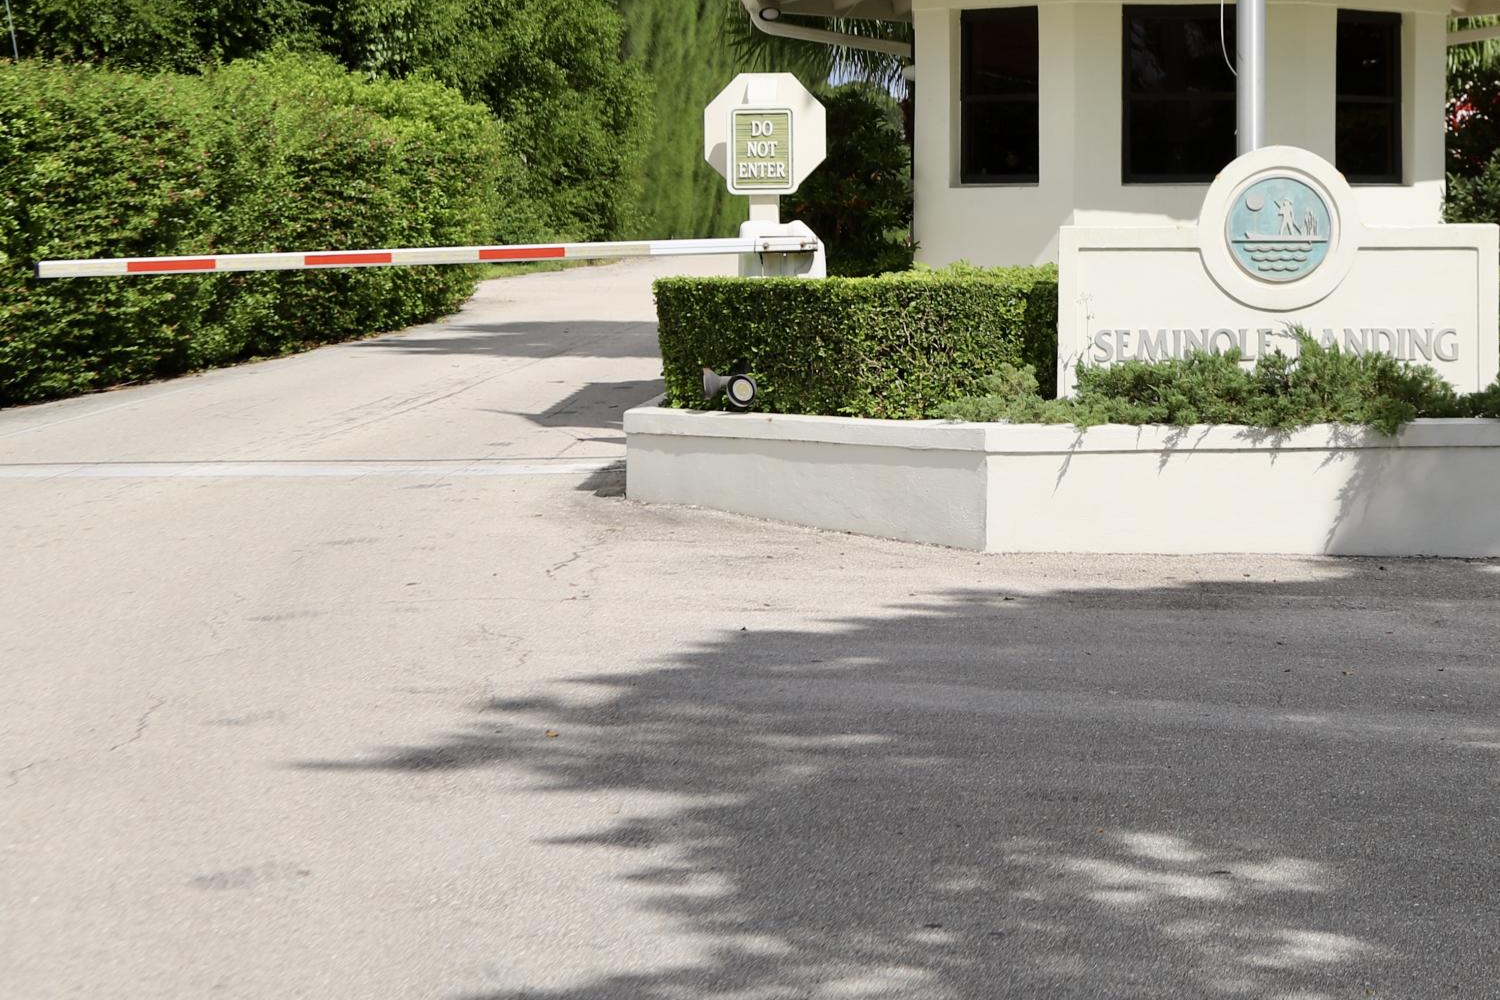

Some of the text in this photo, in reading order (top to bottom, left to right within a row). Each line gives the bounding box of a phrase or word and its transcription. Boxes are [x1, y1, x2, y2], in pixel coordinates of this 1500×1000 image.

[751, 120, 773, 137] DO
[746, 141, 777, 158] NOT
[738, 162, 786, 179] ENTER
[1296, 328, 1460, 362] ANDING
